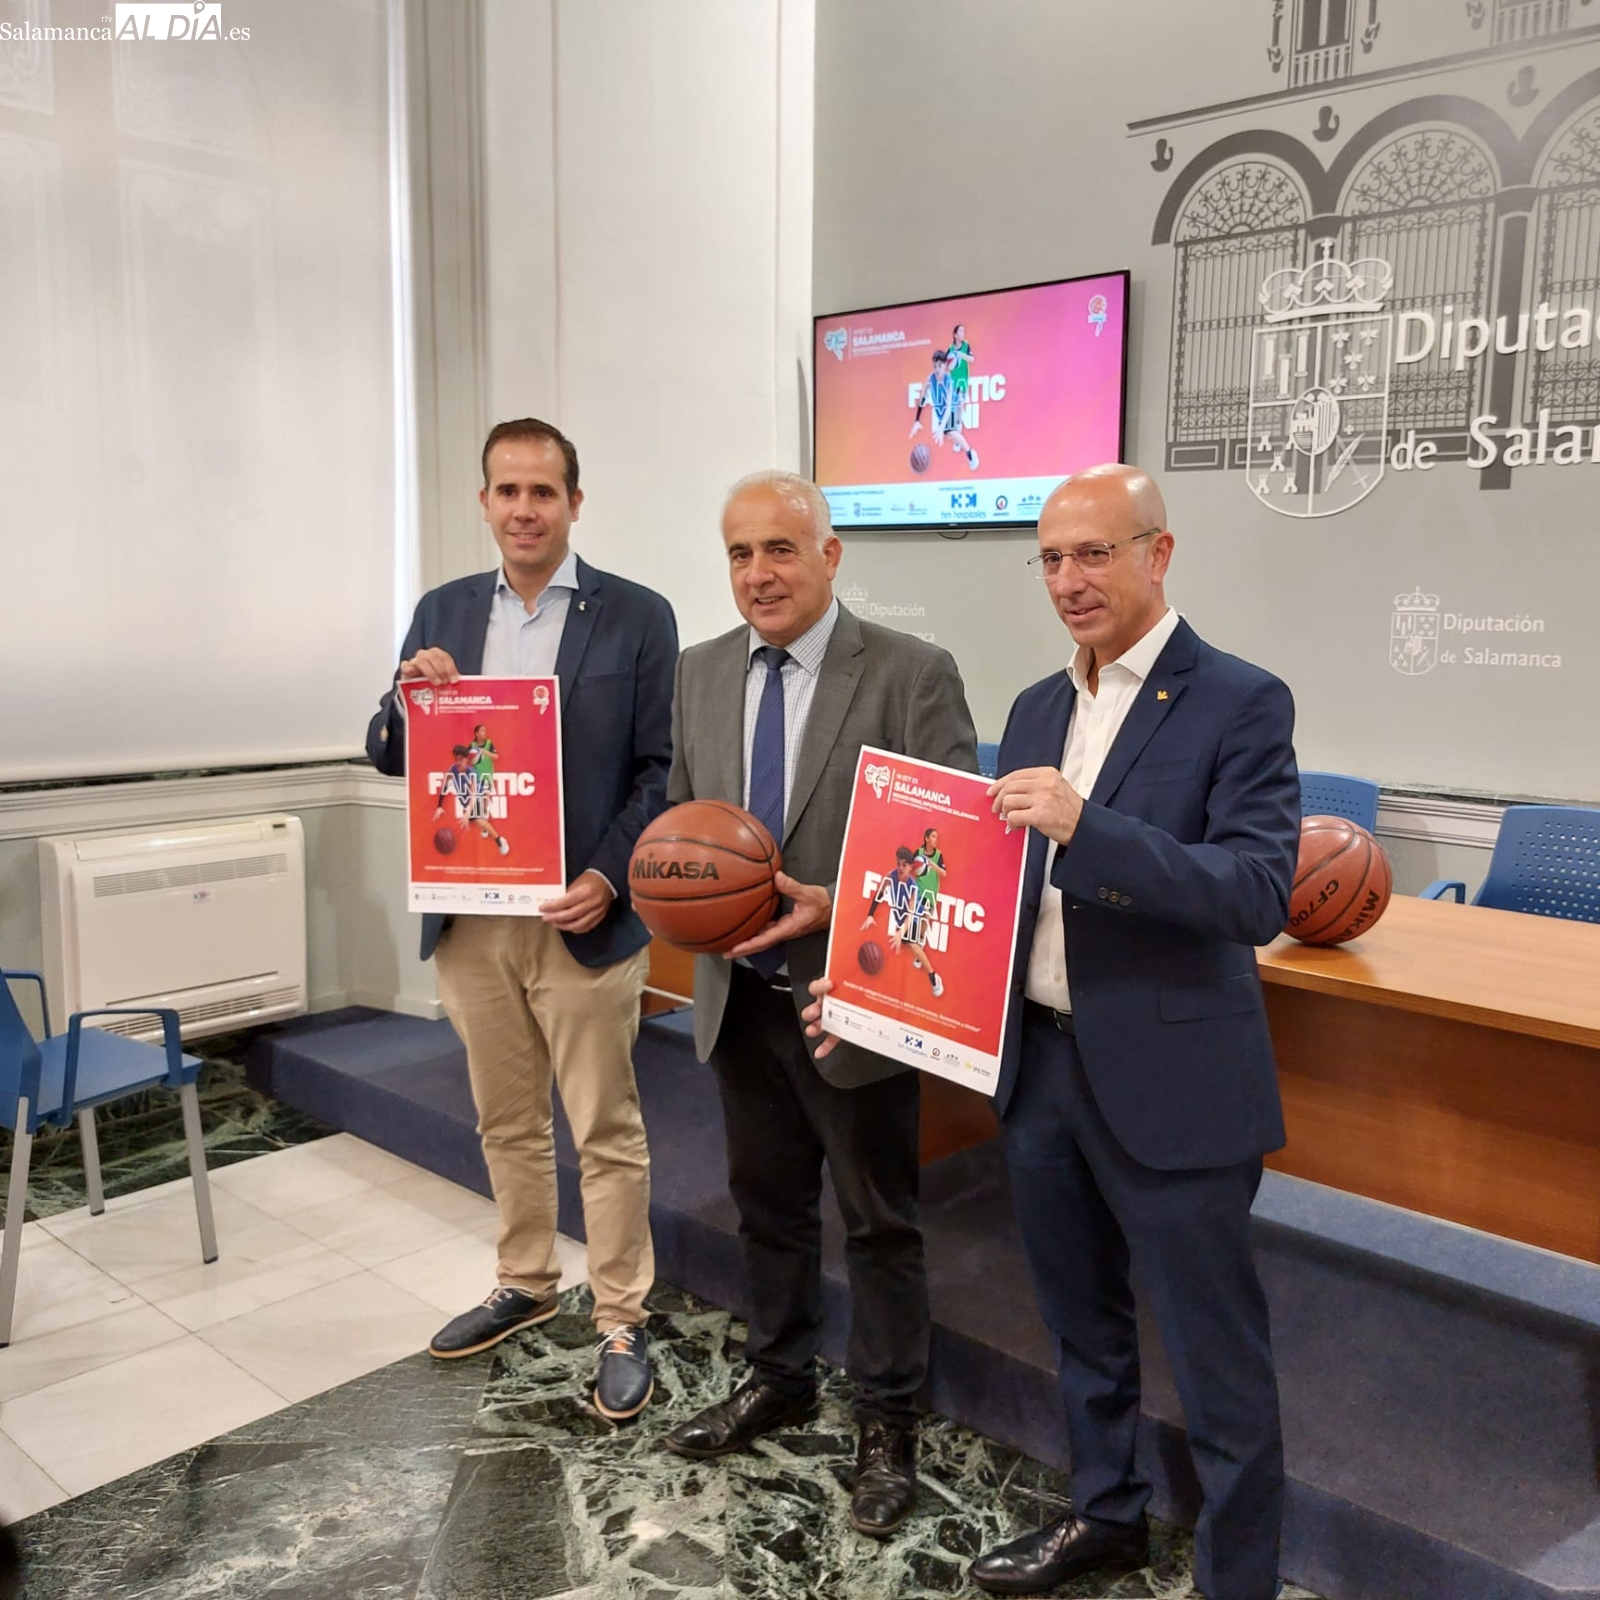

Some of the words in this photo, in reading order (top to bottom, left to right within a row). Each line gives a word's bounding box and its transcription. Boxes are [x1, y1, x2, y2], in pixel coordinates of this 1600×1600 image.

[1395, 302, 1600, 371] Diputa
[908, 374, 1006, 408] FANATIC
[1391, 430, 1437, 471] de
[869, 602, 926, 618] Diputación
[1443, 613, 1545, 634] Diputación
[1440, 650, 1457, 664] de
[1463, 647, 1562, 668] Salamanca
[428, 772, 536, 796] FANATIC
[893, 781, 952, 806] SALAMANCA
[455, 795, 508, 820] MINI
[862, 870, 986, 933] FANATIC
[1290, 880, 1340, 928] CF700
[887, 907, 949, 953] MINI
